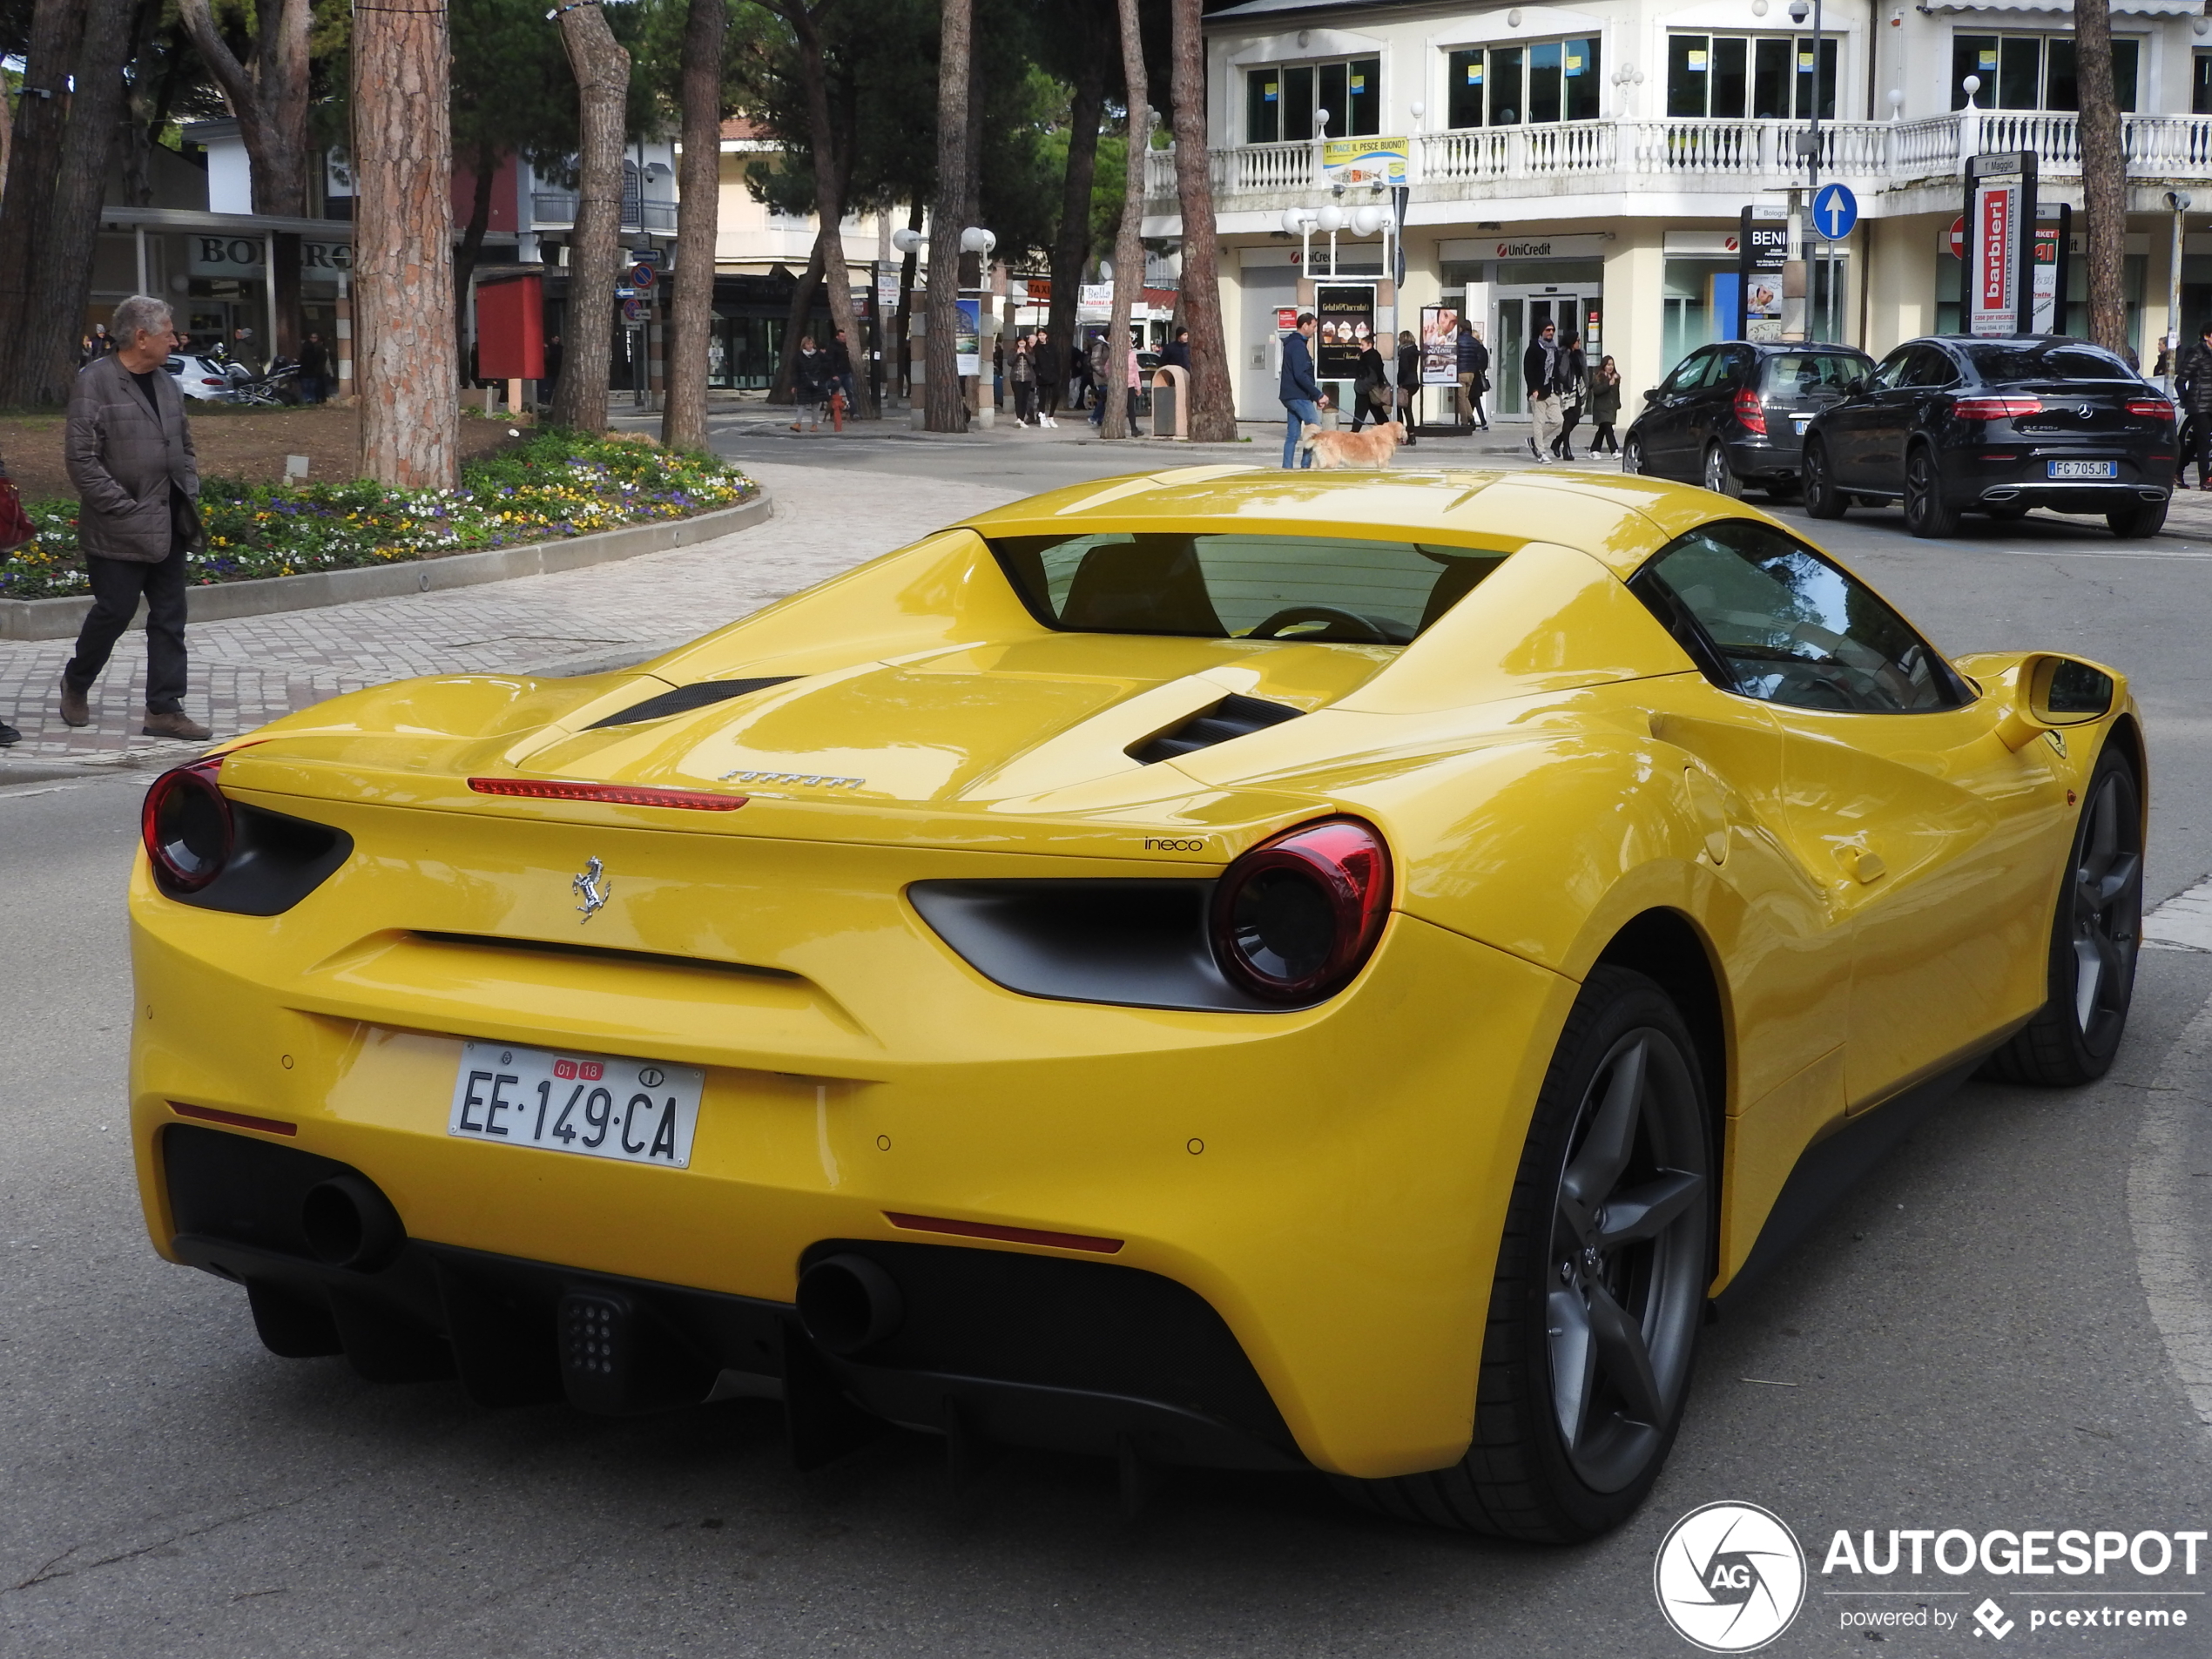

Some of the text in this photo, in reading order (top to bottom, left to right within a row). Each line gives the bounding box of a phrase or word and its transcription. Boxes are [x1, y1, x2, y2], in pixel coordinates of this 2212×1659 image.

[1360, 142, 1378, 152] PESCE
[1381, 140, 1406, 150] BUONO?
[1991, 160, 2013, 172] Maggio
[199, 238, 356, 269] BORO
[1508, 243, 1551, 255] UniCredit
[1987, 201, 2002, 298] barbieri
[1029, 285, 1050, 294] TAXI
[718, 770, 866, 790] Ferrari
[1144, 836, 1203, 852] ineco
[557, 1064, 570, 1076] 01
[584, 1065, 597, 1077] 18
